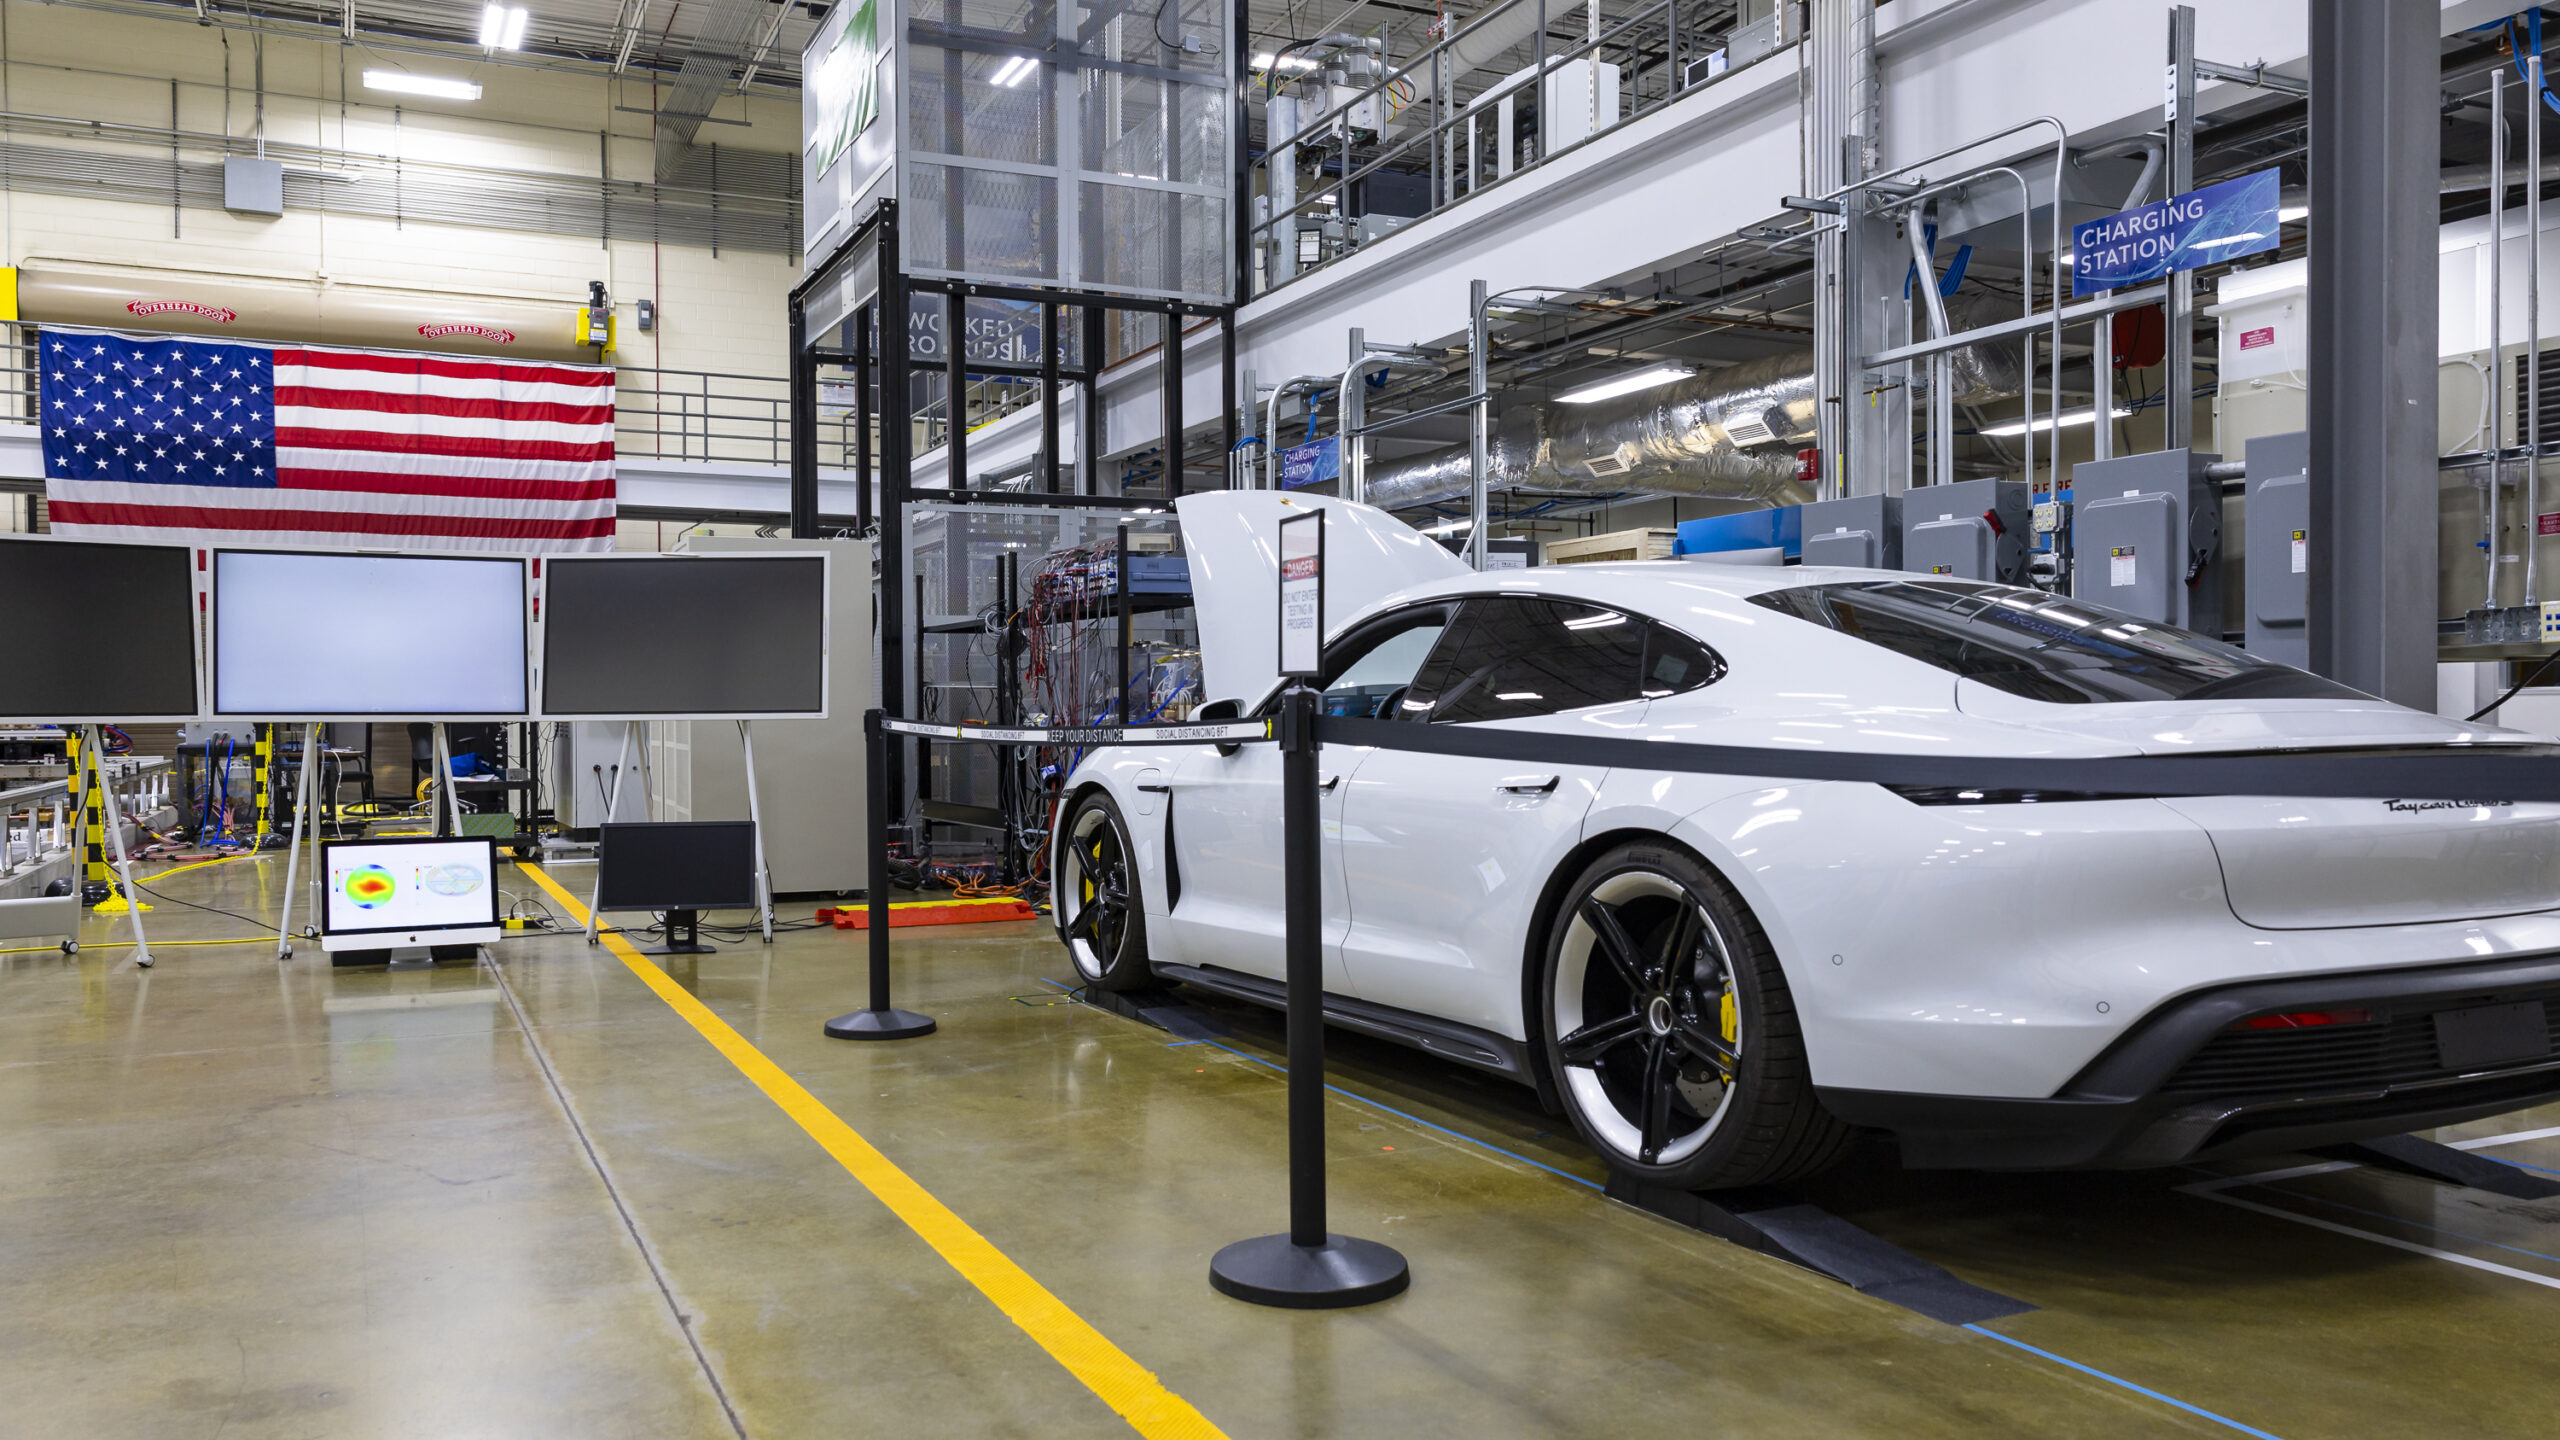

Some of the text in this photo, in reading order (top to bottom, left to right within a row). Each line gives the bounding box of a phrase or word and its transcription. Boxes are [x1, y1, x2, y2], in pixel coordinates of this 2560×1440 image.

[2080, 198, 2205, 249] CHARGING
[2080, 232, 2175, 274] STATION
[139, 303, 224, 322] OVERHEAD DOOR
[428, 325, 504, 343] OVERHEAD DOOR
[1284, 445, 1321, 465] CHARGING
[1284, 461, 1313, 479] STATION
[1287, 559, 1315, 578] DANGER
[1283, 592, 1290, 604] DO
[1291, 590, 1301, 602] NOT
[1287, 604, 1307, 617] TESTING
[1287, 617, 1313, 630] PROGRESS
[1047, 729, 1123, 742] KEEP YOUR DISTANCE
[1156, 728, 1177, 739] SOCIAL
[1178, 727, 1216, 739] DISTANCING
